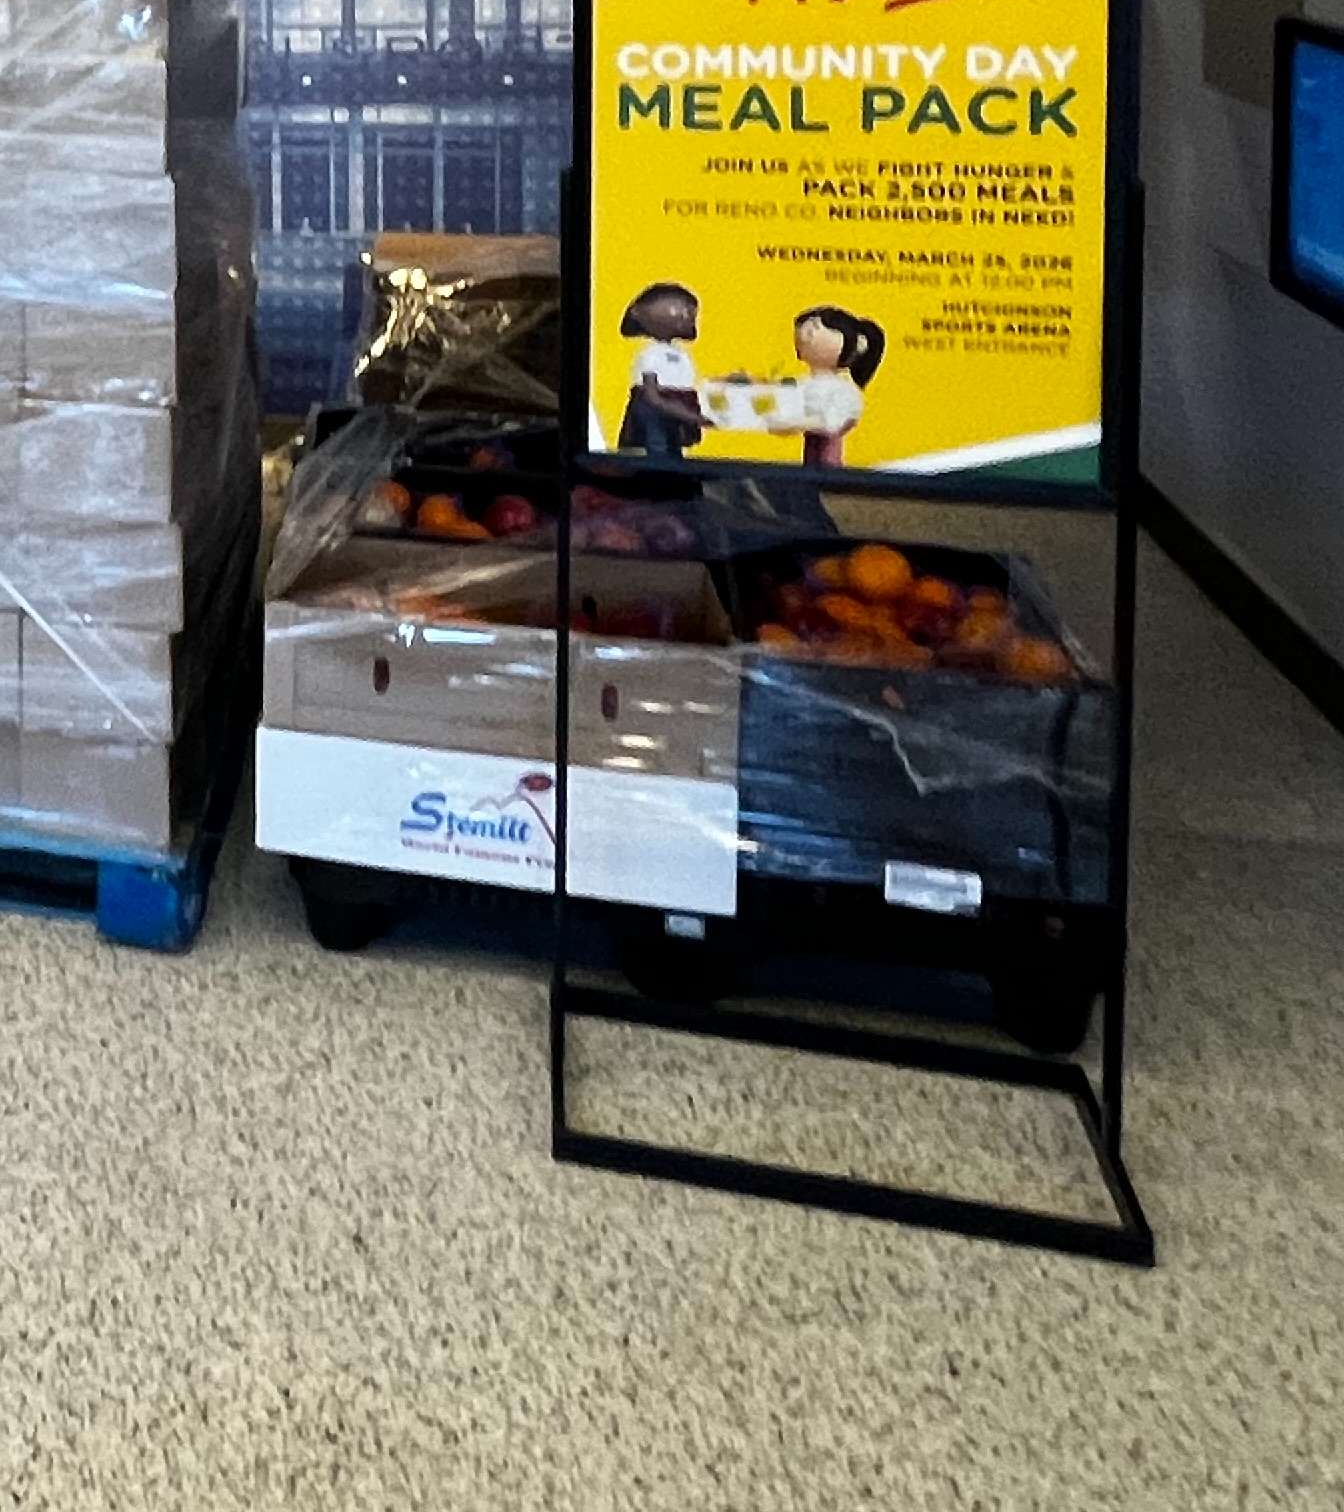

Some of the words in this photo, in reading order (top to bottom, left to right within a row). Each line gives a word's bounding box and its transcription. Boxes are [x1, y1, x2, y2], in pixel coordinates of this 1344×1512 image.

[616, 42, 946, 81] COMMUNITY
[966, 42, 1078, 82] DAY
[618, 83, 829, 136] MEAL
[862, 87, 1078, 138] PACK
[704, 157, 754, 175] JOIN
[760, 159, 789, 175] US
[797, 159, 828, 177] AS
[834, 161, 869, 177] WE
[877, 161, 945, 179] FIGHT
[953, 163, 1052, 180] HUNGER
[803, 178, 874, 199] PACK
[886, 179, 965, 204] 2,500
[976, 181, 1075, 205] MEALS
[663, 199, 708, 217] FOR
[716, 199, 776, 218] RENO
[828, 205, 963, 224] NEIGHBORS
[972, 208, 996, 226] IN
[1004, 209, 1075, 227] NEED!
[899, 250, 974, 267] MARCH
[400, 791, 531, 842] Stemilt
